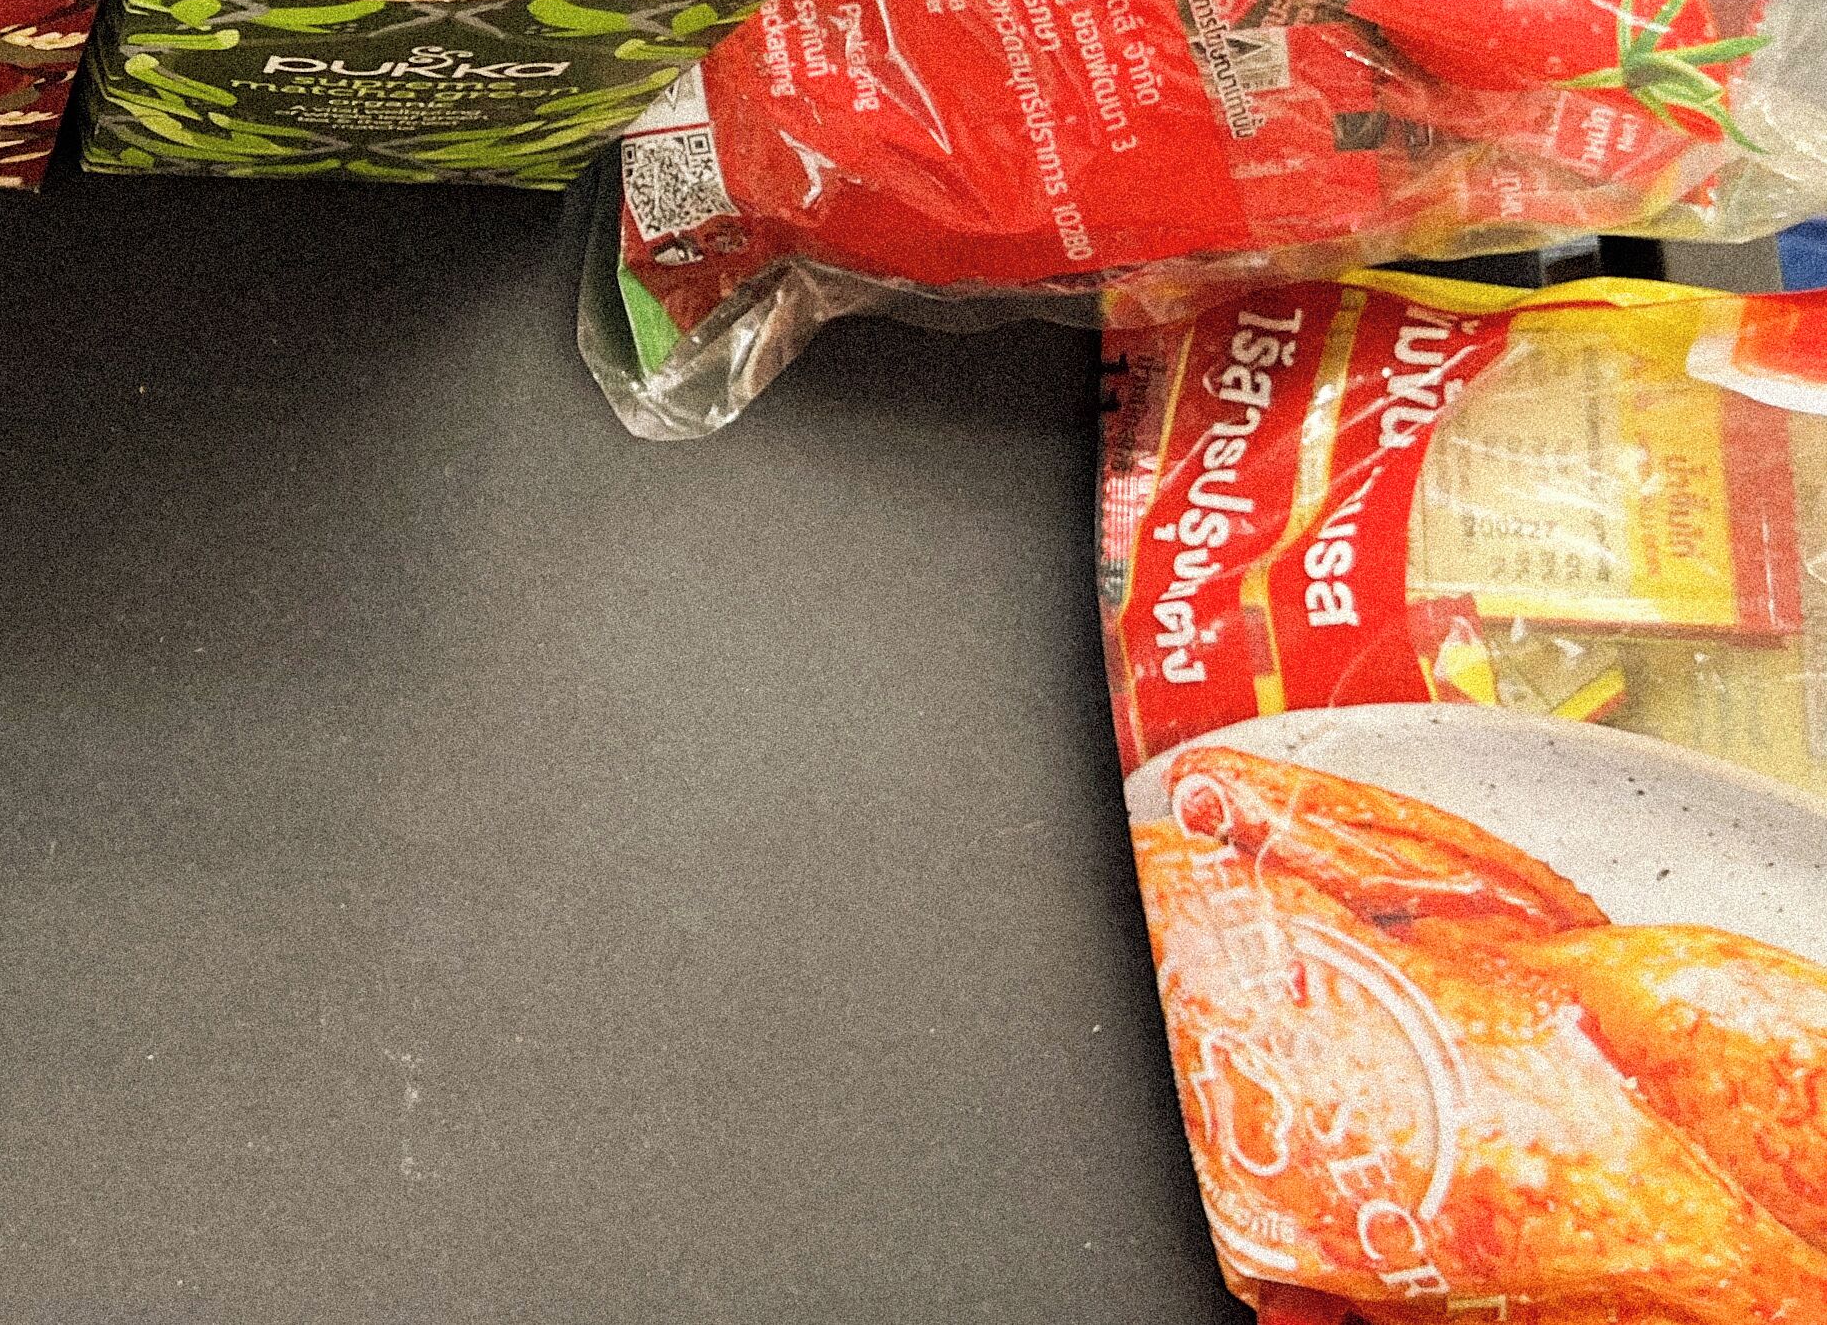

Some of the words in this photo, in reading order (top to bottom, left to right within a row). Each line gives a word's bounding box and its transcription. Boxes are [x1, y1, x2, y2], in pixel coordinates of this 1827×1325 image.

[435, 85, 579, 101] green
[1072, 8, 1127, 132] ซอยพัฒนา
[1112, 134, 1138, 154] 3
[1121, 40, 1161, 107] จำกัด
[1052, 203, 1095, 261] 10280
[1152, 308, 1305, 686] ไร้สารปรุงแต่ง
